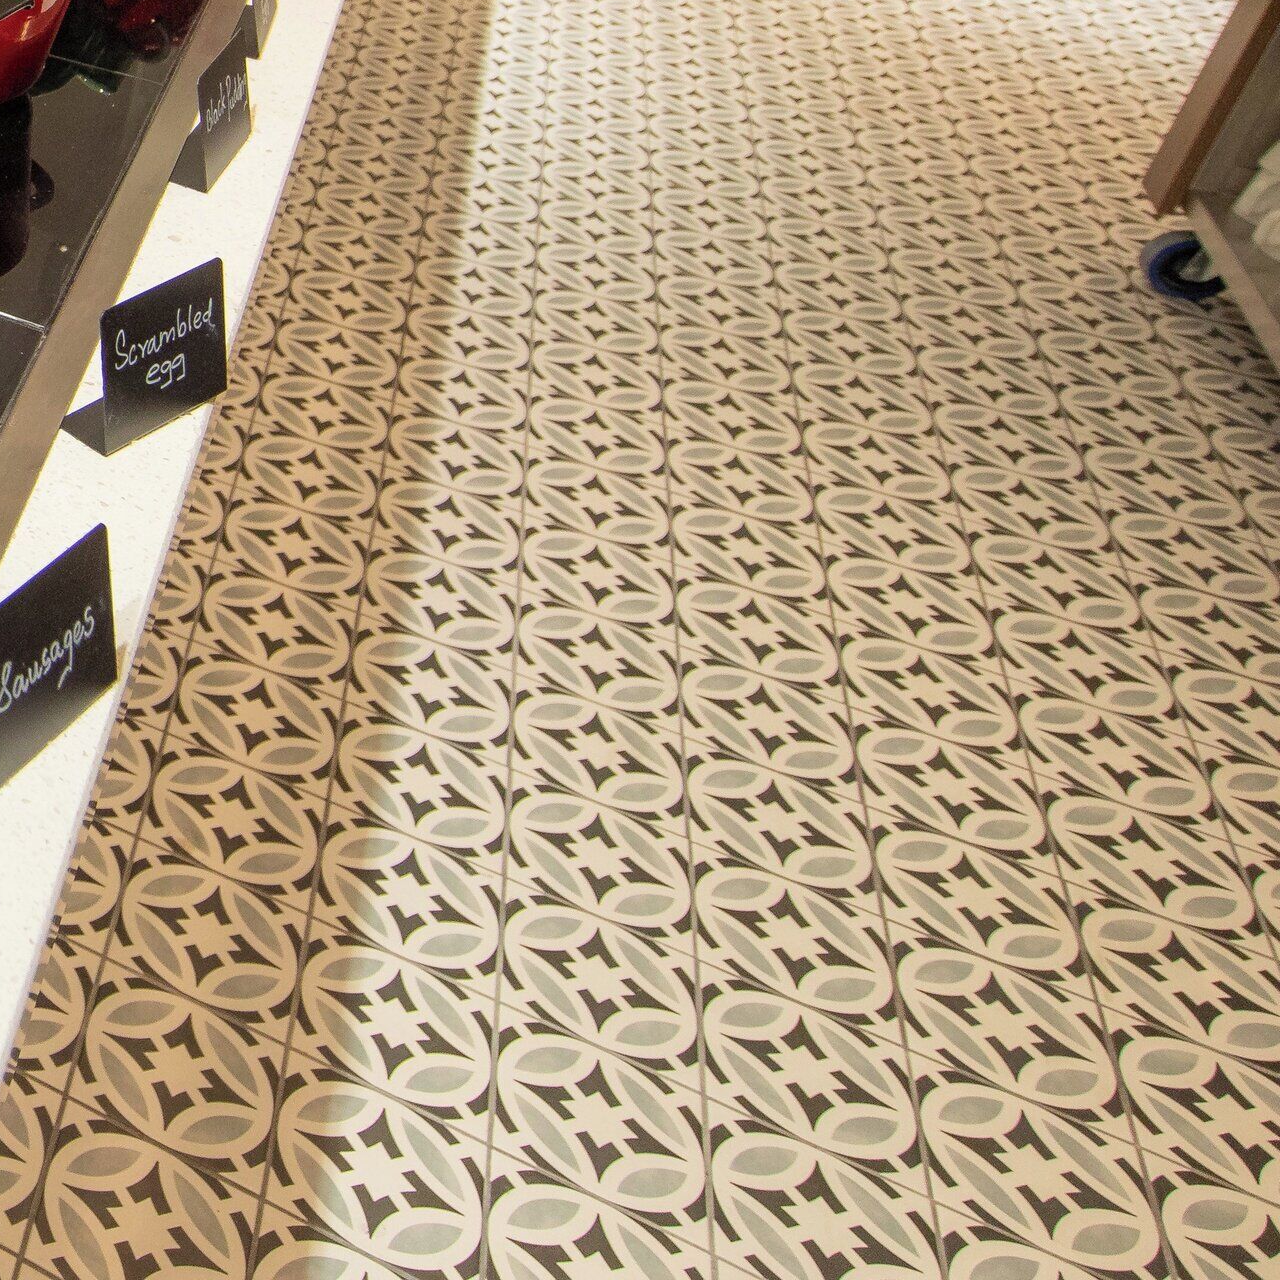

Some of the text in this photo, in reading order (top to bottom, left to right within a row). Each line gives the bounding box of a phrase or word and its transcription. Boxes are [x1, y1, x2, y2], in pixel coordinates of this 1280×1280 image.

[206, 81, 227, 132] Black
[115, 296, 216, 370] Scrambled
[145, 352, 187, 390] egg
